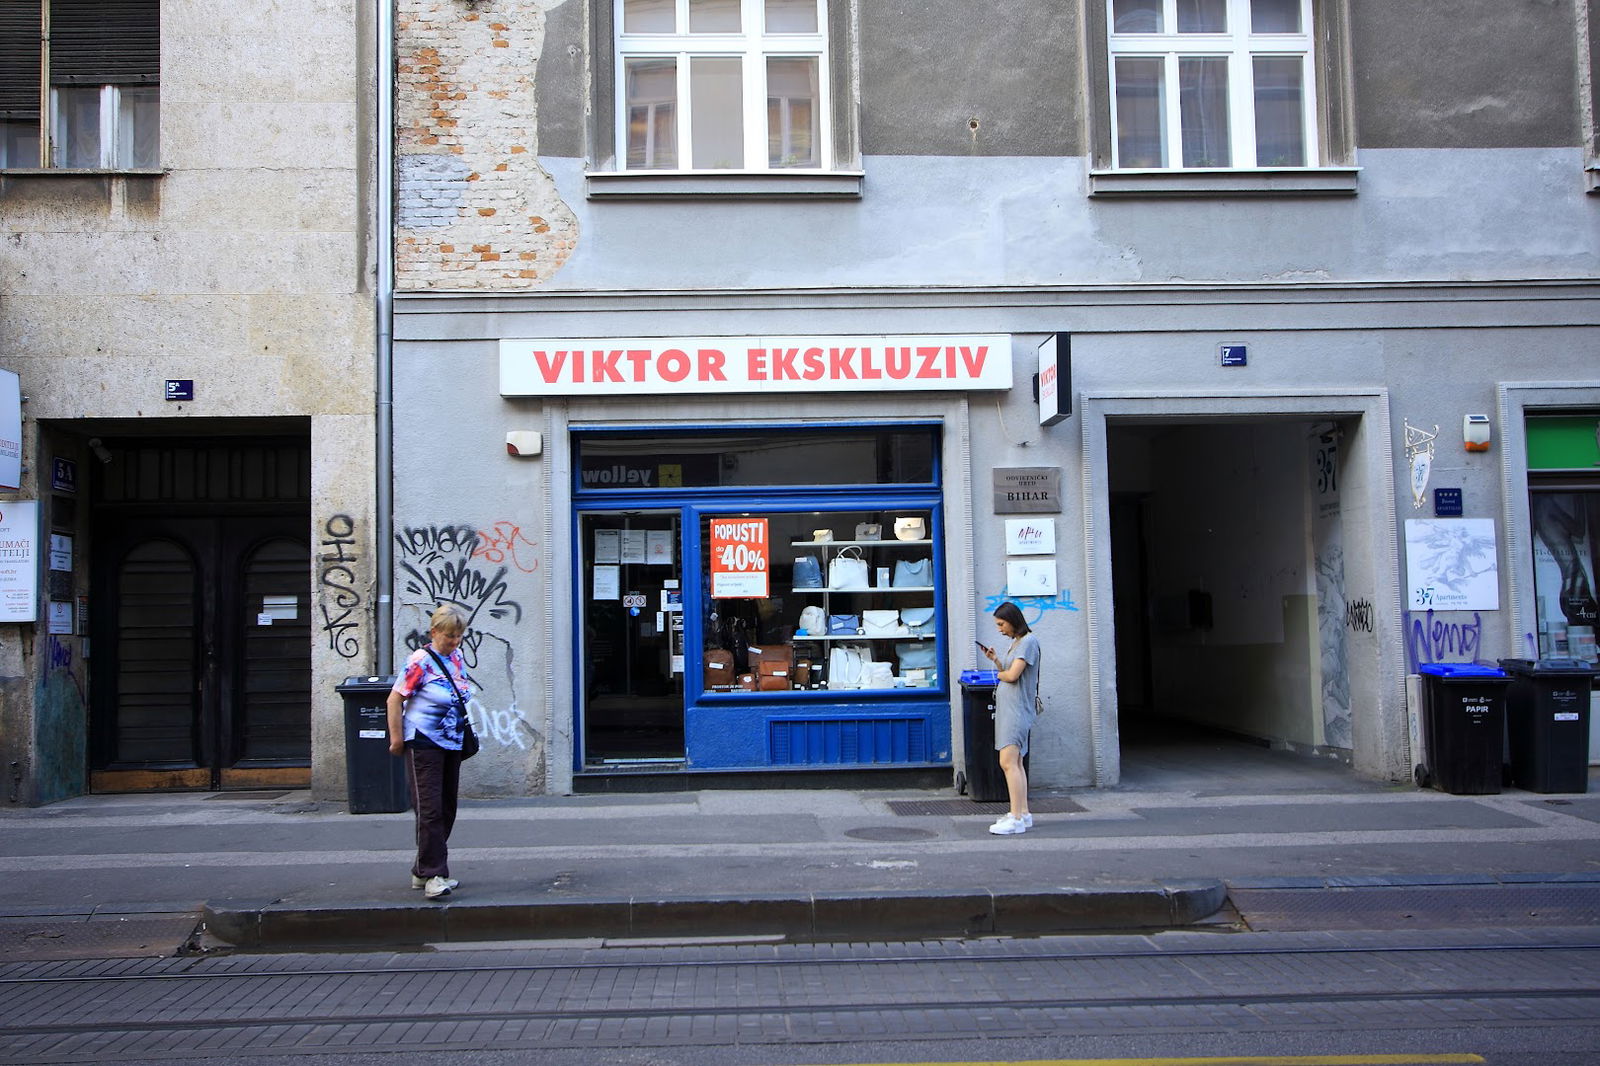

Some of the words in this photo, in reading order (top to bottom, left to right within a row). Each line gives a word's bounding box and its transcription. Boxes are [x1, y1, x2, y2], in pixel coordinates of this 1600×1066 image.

[1224, 348, 1231, 358] 7
[532, 349, 728, 384] VIKTOR
[747, 345, 990, 381] EKSKLUZIV
[1007, 491, 1048, 501] BIHAR
[714, 522, 764, 544] POPUSTI
[721, 544, 766, 571] 40%
[1416, 587, 1435, 606] 37
[1466, 705, 1489, 713] PAPIR
